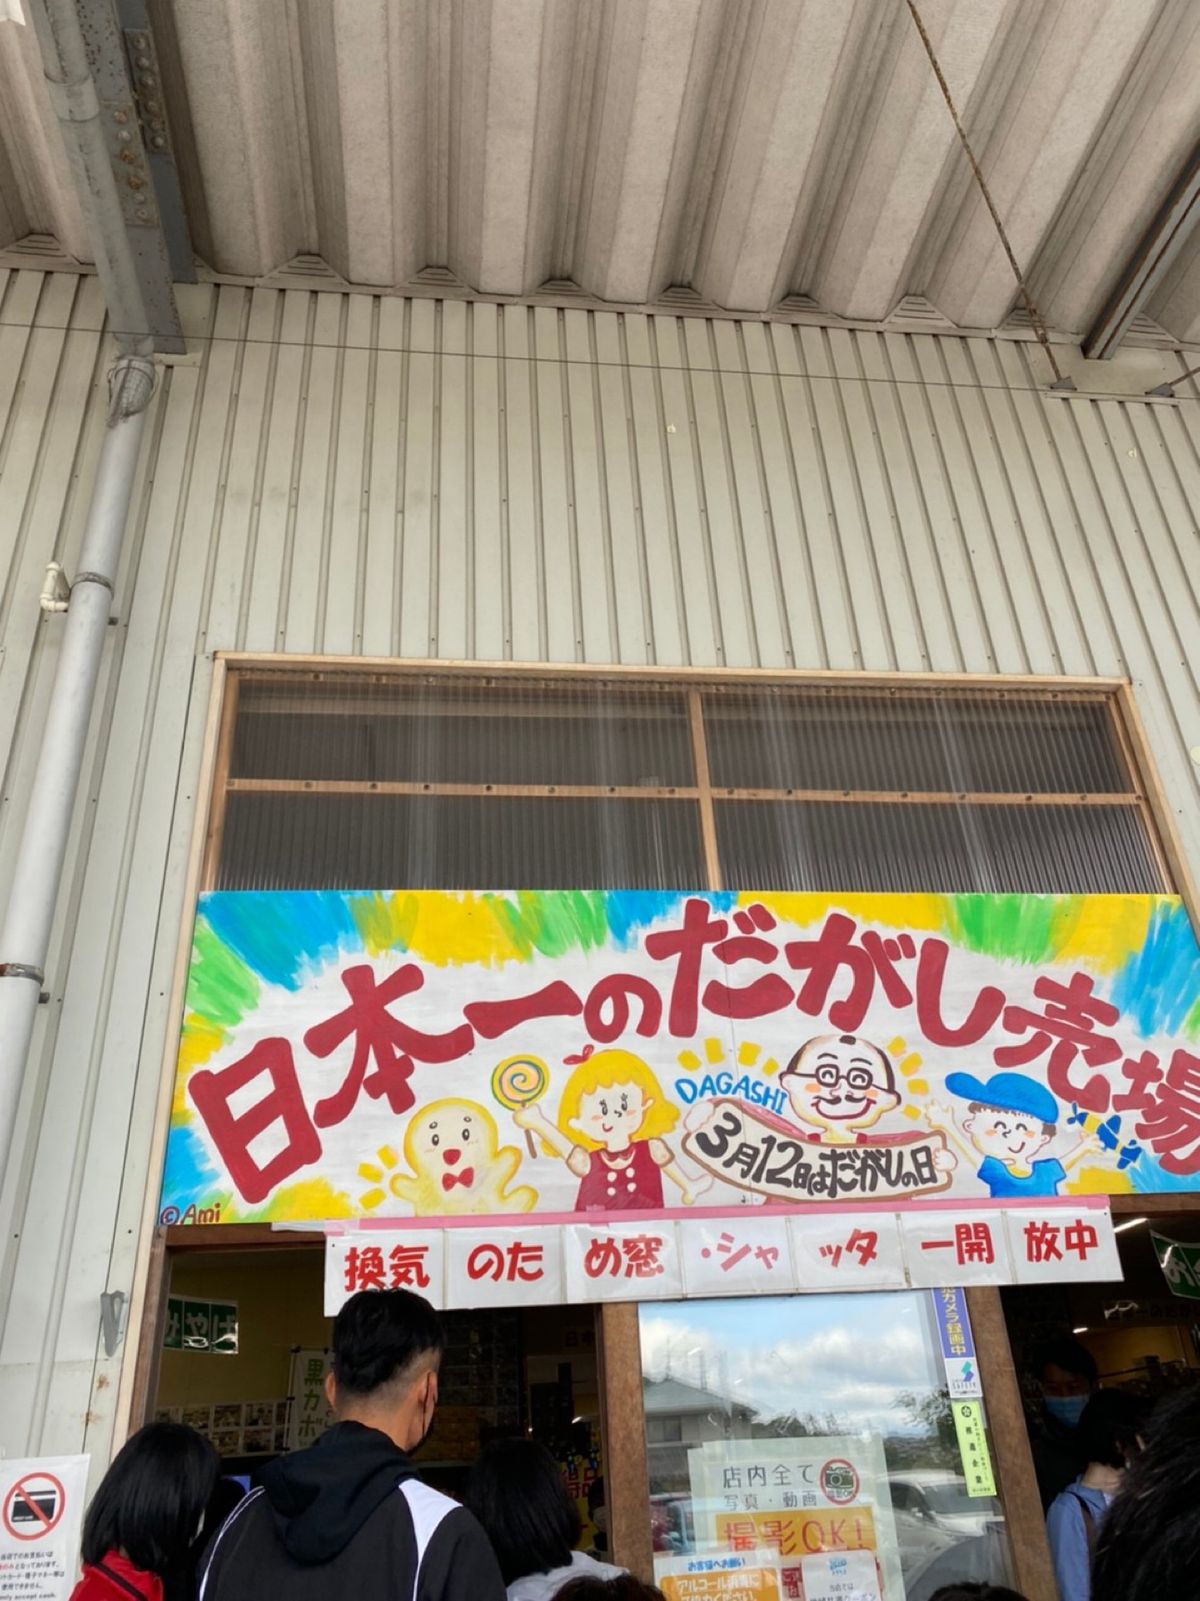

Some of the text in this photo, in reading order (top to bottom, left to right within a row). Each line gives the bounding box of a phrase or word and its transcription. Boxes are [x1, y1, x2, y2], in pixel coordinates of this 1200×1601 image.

[188, 898, 1200, 1203] 日本一のだがし売場
[675, 1072, 787, 1115] DAGASHI
[723, 1464, 814, 1488] 店内全て
